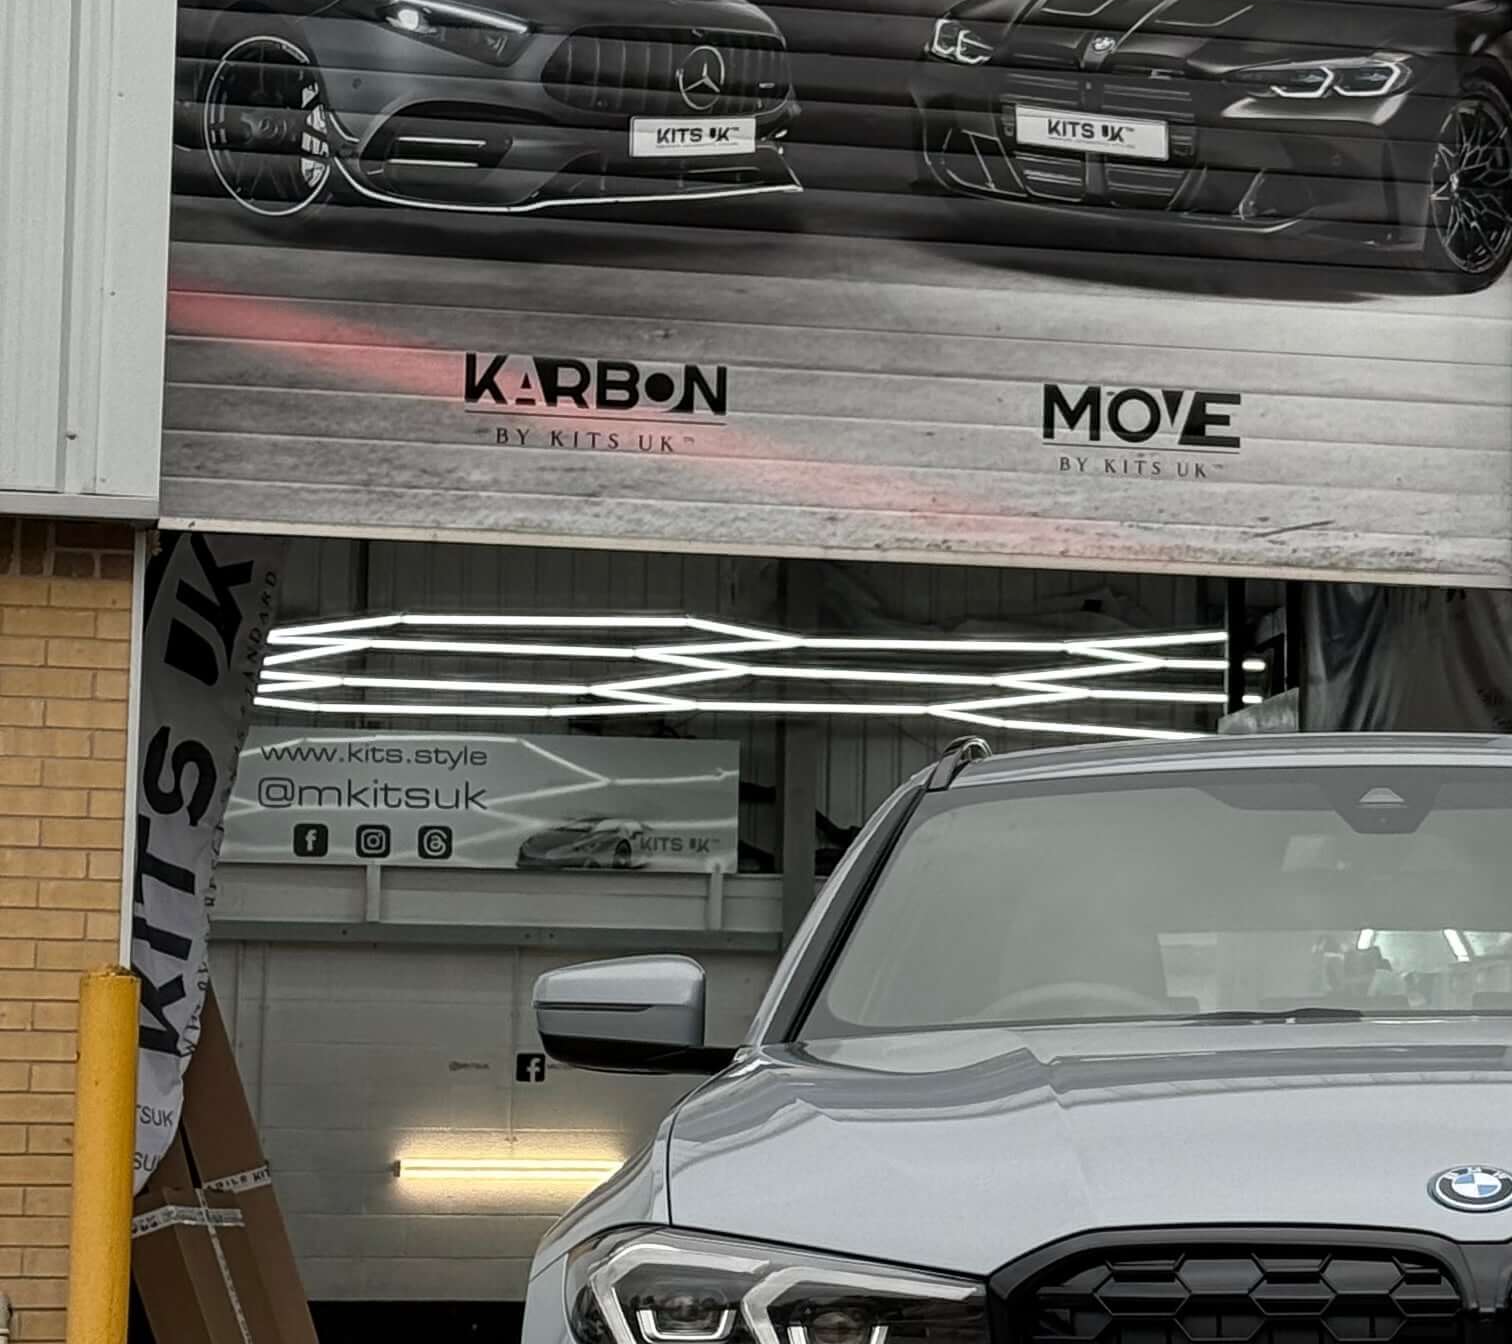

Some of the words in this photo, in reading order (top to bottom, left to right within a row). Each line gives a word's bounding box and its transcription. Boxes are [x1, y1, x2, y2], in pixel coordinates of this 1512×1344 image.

[657, 127, 702, 144] KITS
[1048, 119, 1094, 138] KITS
[464, 352, 727, 415] KARBON
[1043, 383, 1241, 448] MOVE
[496, 427, 530, 445] BY
[551, 429, 619, 449] KITS
[1059, 456, 1088, 472] BY
[1104, 459, 1161, 475] KITS
[260, 743, 488, 771] www.kits.style
[258, 777, 488, 810] @mkitsuk
[640, 836, 683, 853] KITS
[129, 725, 217, 1058] KITS
